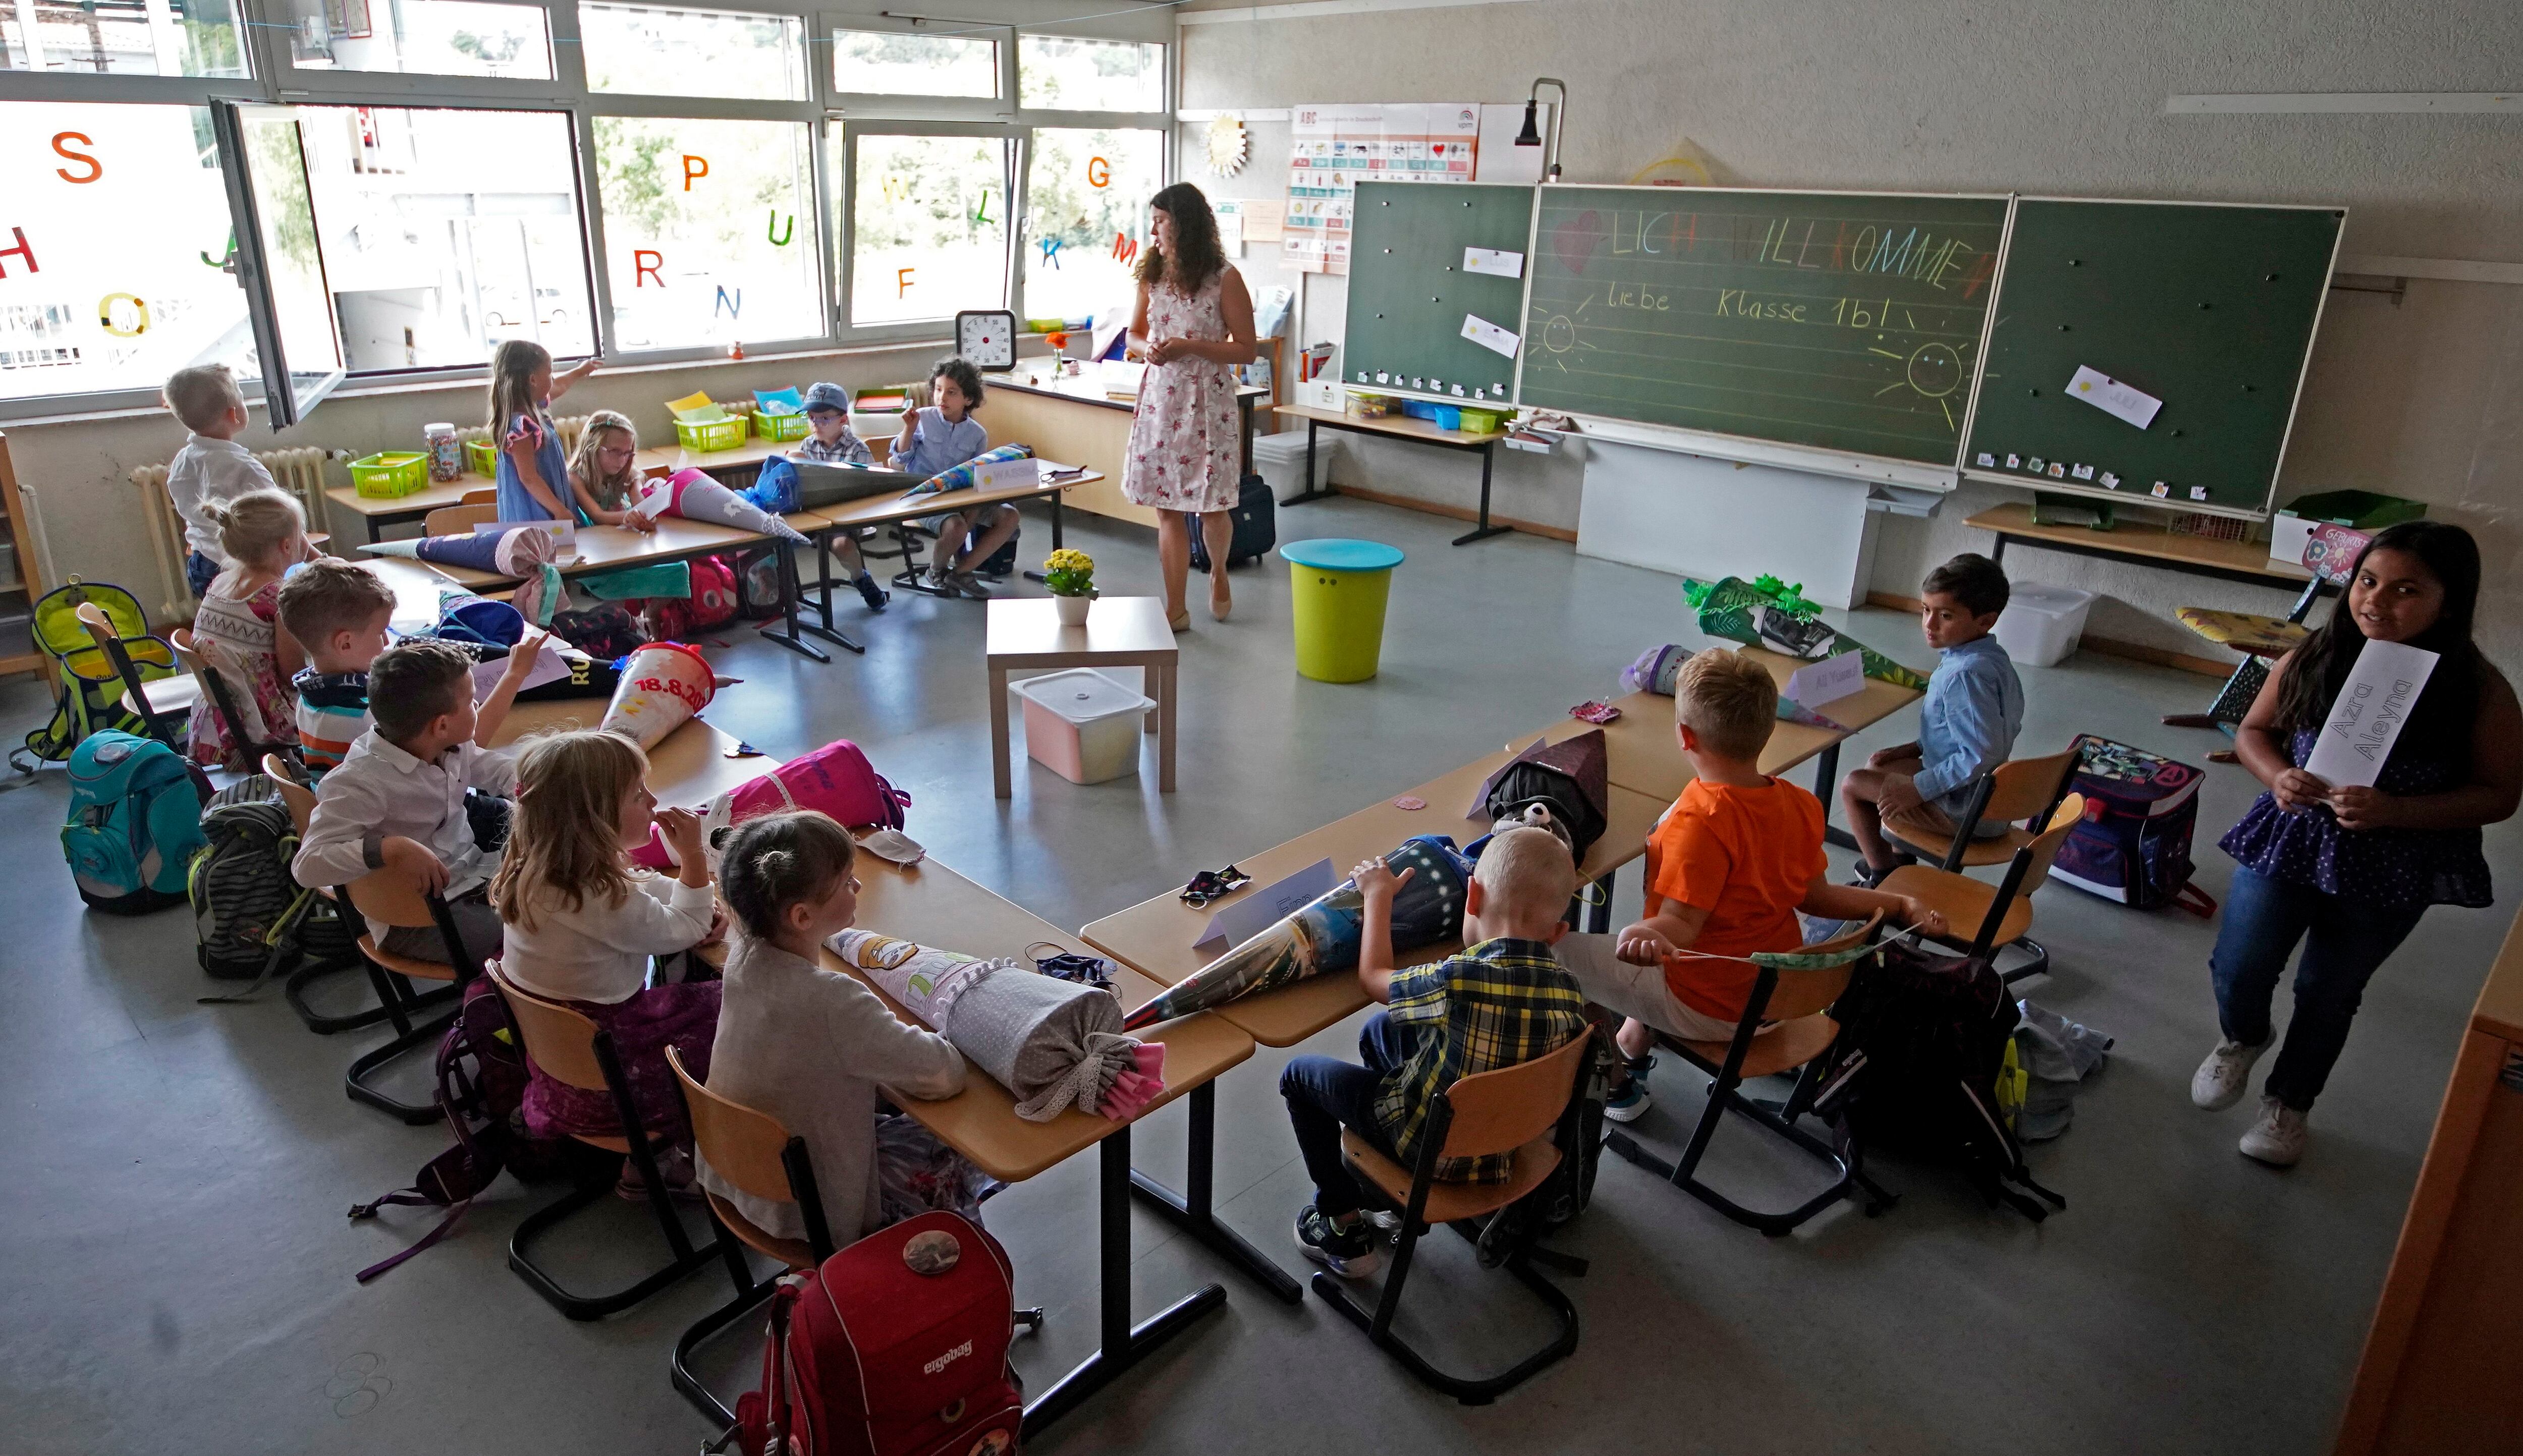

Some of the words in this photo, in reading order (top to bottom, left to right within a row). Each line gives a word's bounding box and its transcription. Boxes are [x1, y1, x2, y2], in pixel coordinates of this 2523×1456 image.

[1300, 111, 1317, 125] ABC
[52, 131, 103, 184] S
[683, 155, 708, 192] P
[1088, 157, 1110, 188] G
[882, 177, 909, 204] W
[976, 190, 995, 225] L
[769, 209, 793, 246] U
[1613, 210, 1697, 254] LICH
[1043, 239, 1063, 270] K
[1112, 232, 1138, 268] M
[634, 250, 666, 288] R
[898, 268, 914, 300] F
[98, 293, 151, 338] O
[715, 285, 741, 320] N
[1717, 288, 1807, 323] Klasse
[571, 657, 591, 686] RU
[2329, 683, 2374, 739] Azra
[2354, 679, 2413, 761] Aleyna
[1277, 893, 1312, 918] Finn
[923, 1338, 973, 1375] ergobag
